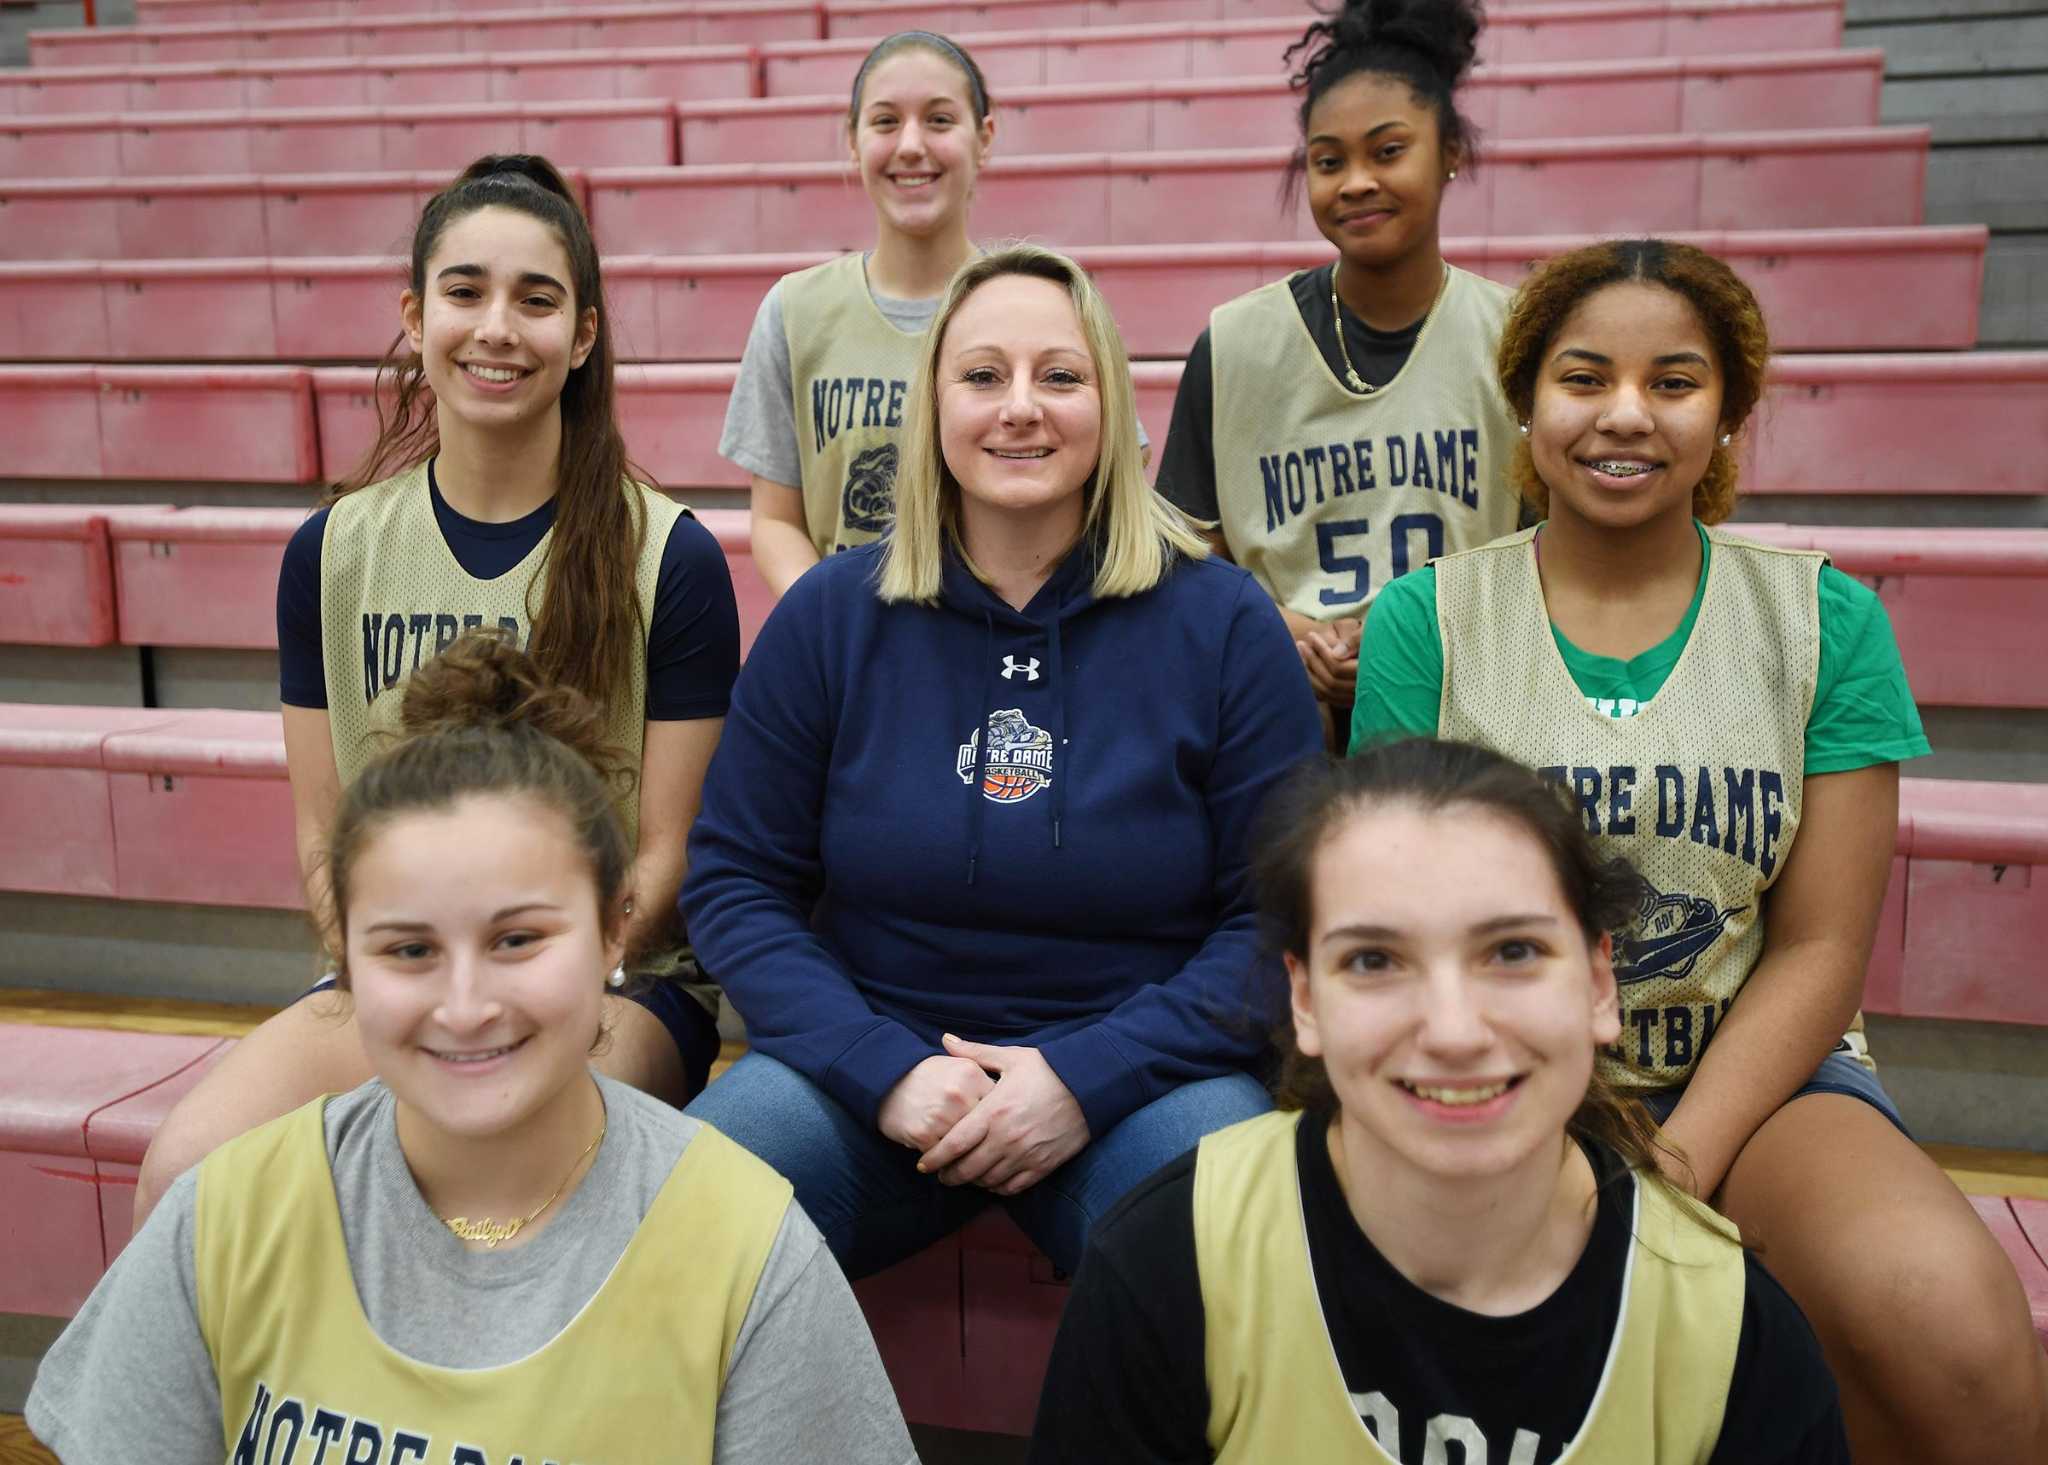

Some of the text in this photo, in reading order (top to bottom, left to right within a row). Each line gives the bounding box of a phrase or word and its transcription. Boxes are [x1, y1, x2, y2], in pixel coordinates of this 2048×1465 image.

[812, 377, 908, 455] NOTRE
[1259, 429, 1479, 534] NOTRE DAME
[1315, 513, 1444, 606] 50
[362, 612, 484, 705] NOTR
[984, 766, 1039, 780] ASKETBALL
[1654, 764, 1784, 881] DAME
[1992, 863, 2008, 884] 7
